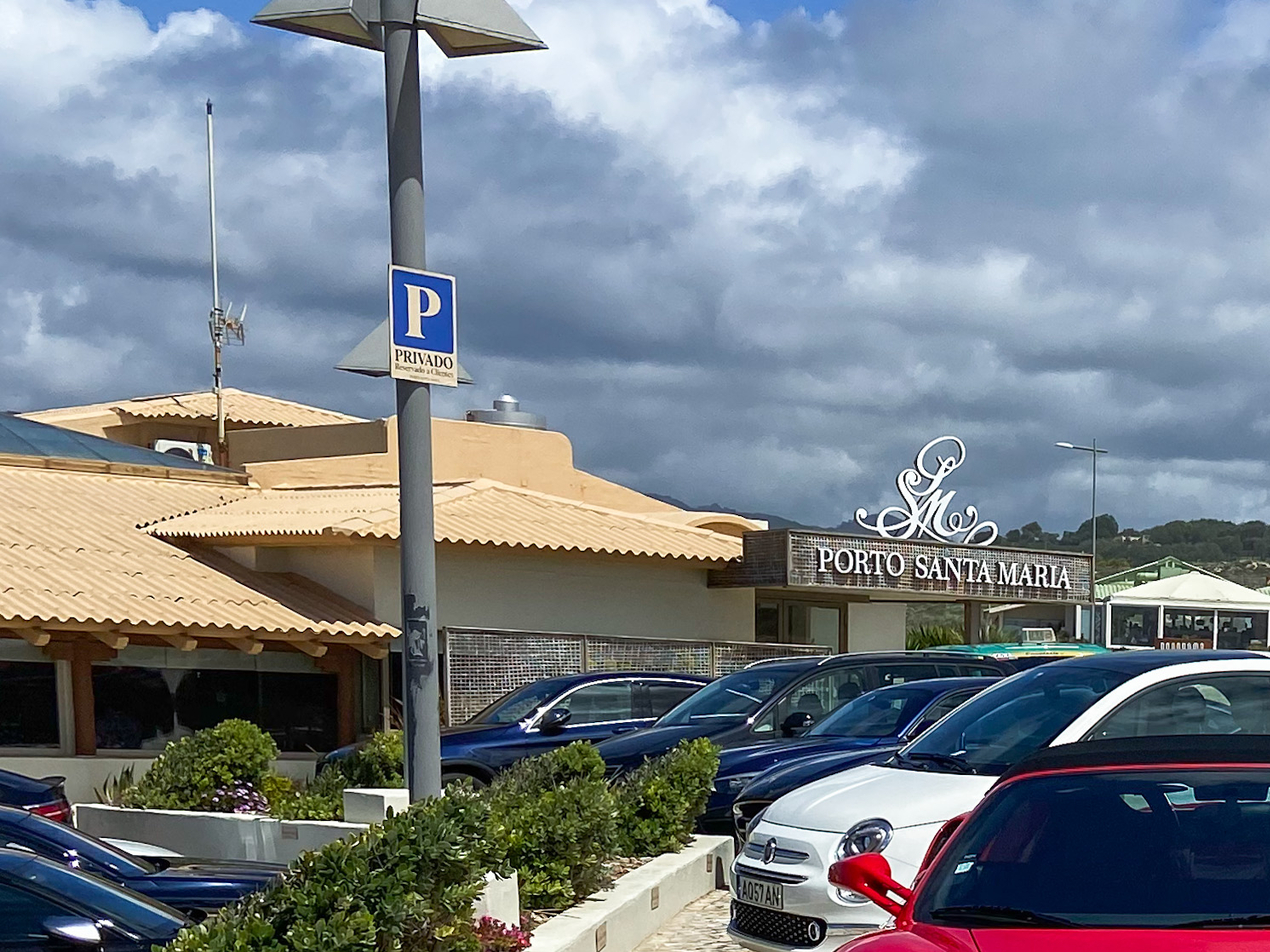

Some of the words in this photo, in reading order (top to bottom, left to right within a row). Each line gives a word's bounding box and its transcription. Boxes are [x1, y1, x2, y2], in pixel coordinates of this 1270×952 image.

[403, 283, 442, 339] P
[395, 349, 453, 370] PRIVADO
[817, 547, 905, 577] PORTO
[914, 554, 993, 584] SANTA
[997, 561, 1072, 590] MARIA
